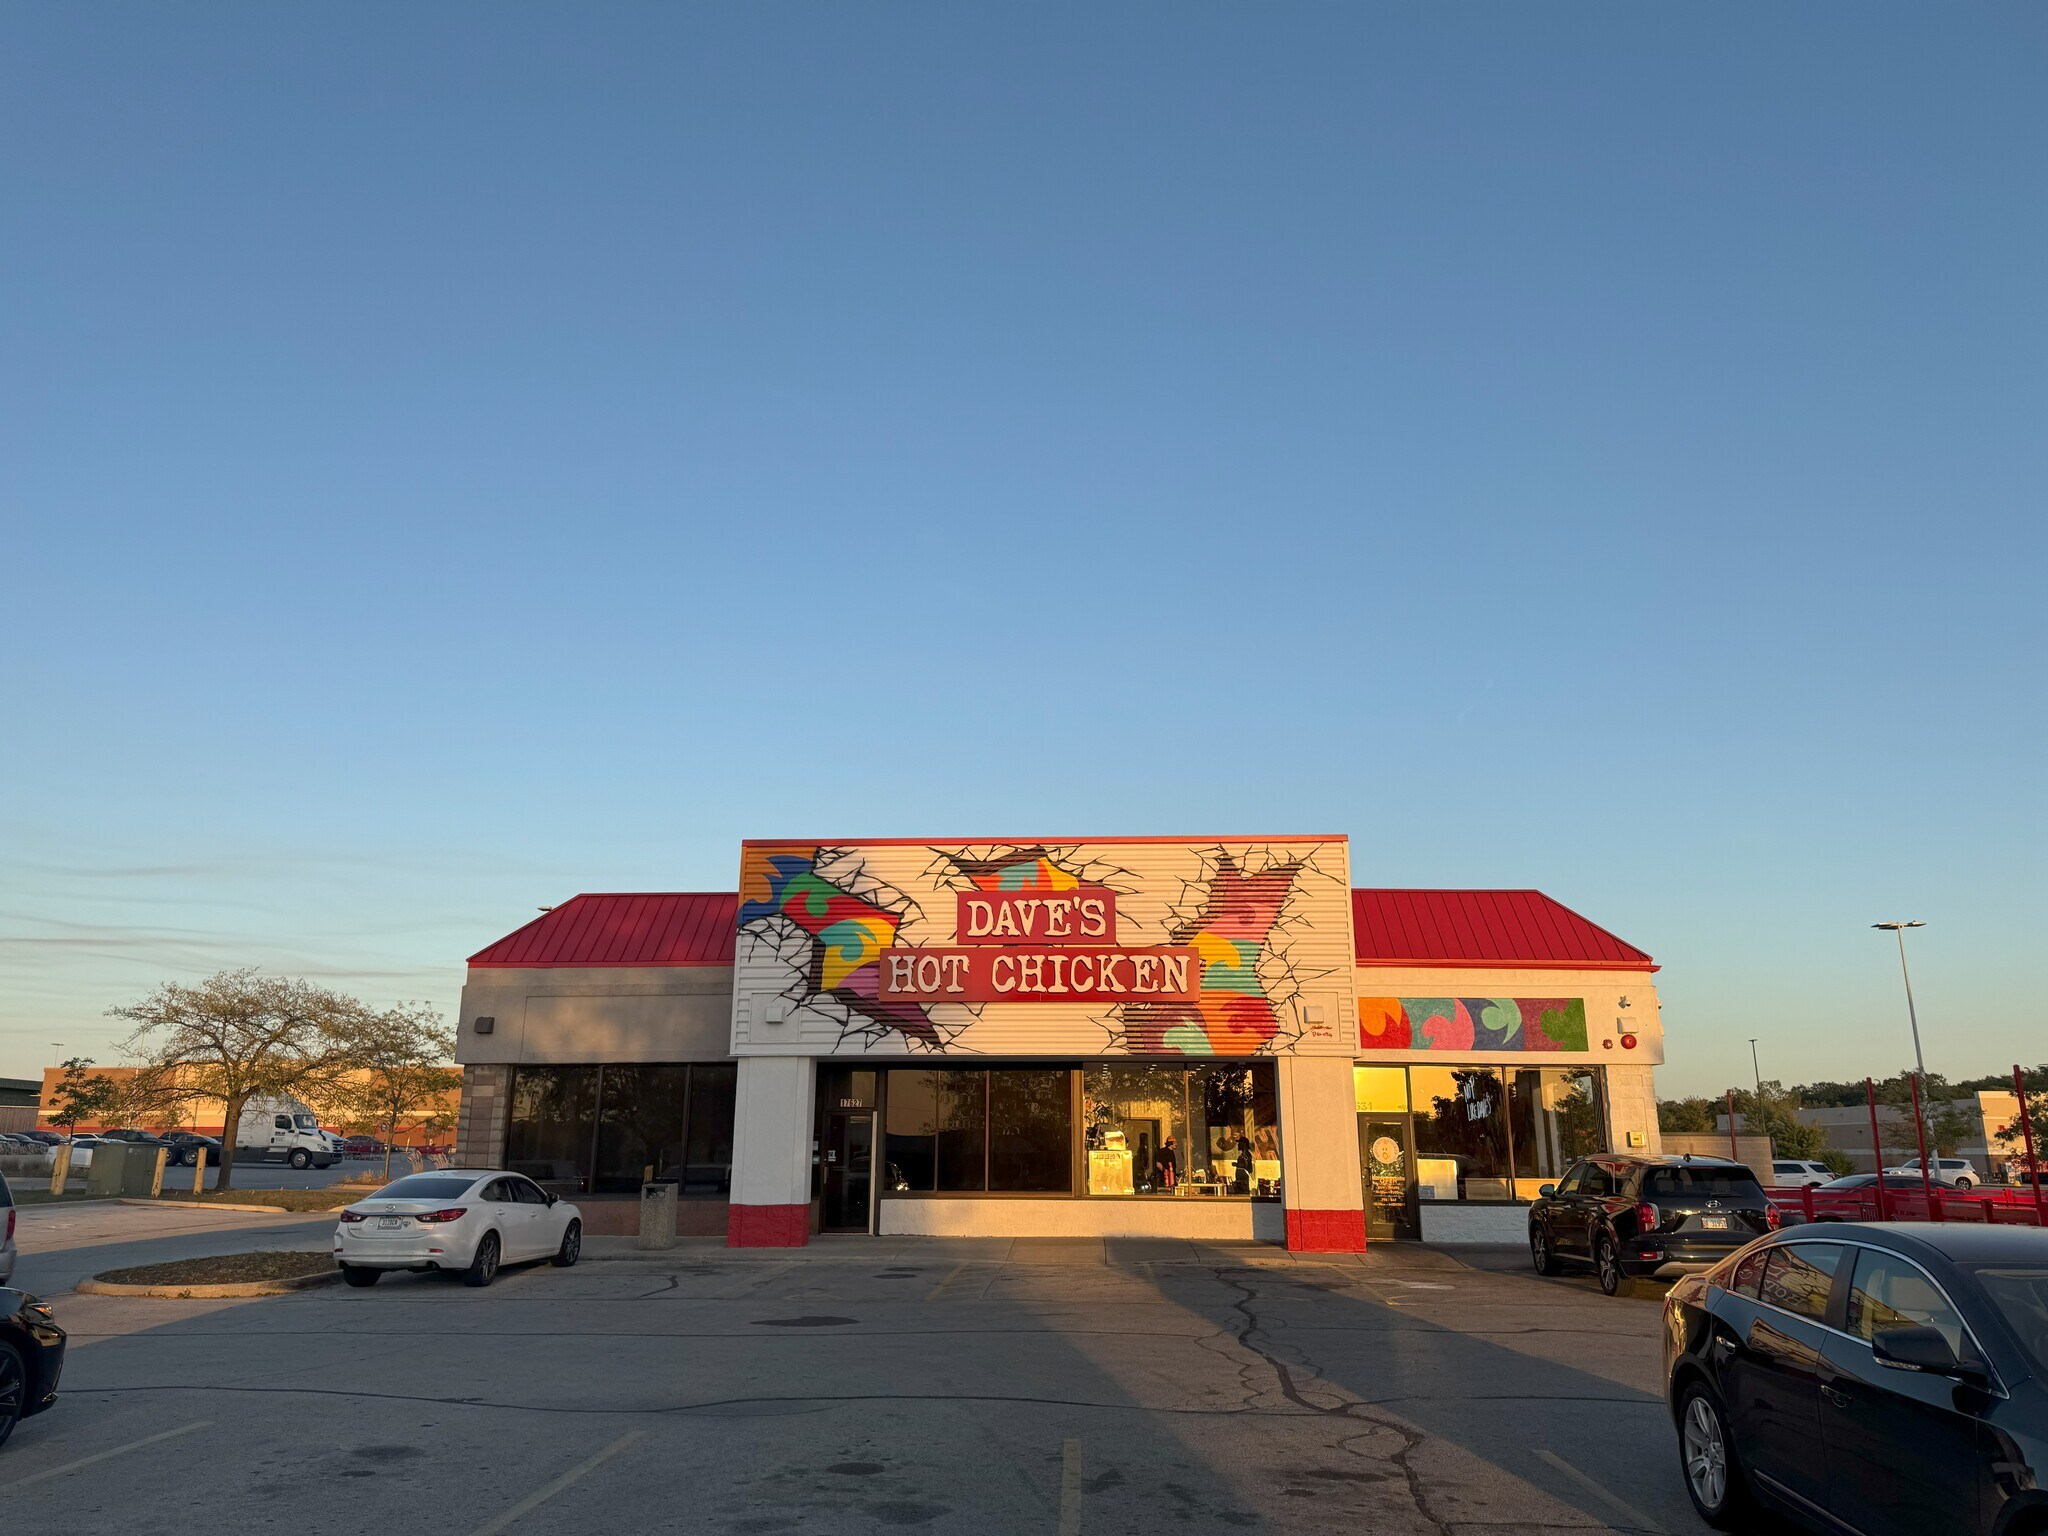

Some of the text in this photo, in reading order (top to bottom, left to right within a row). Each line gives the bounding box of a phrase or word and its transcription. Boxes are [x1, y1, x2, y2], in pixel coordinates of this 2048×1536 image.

[966, 896, 1106, 937] DAVE'S
[887, 955, 1191, 993] HOT CHICKEN
